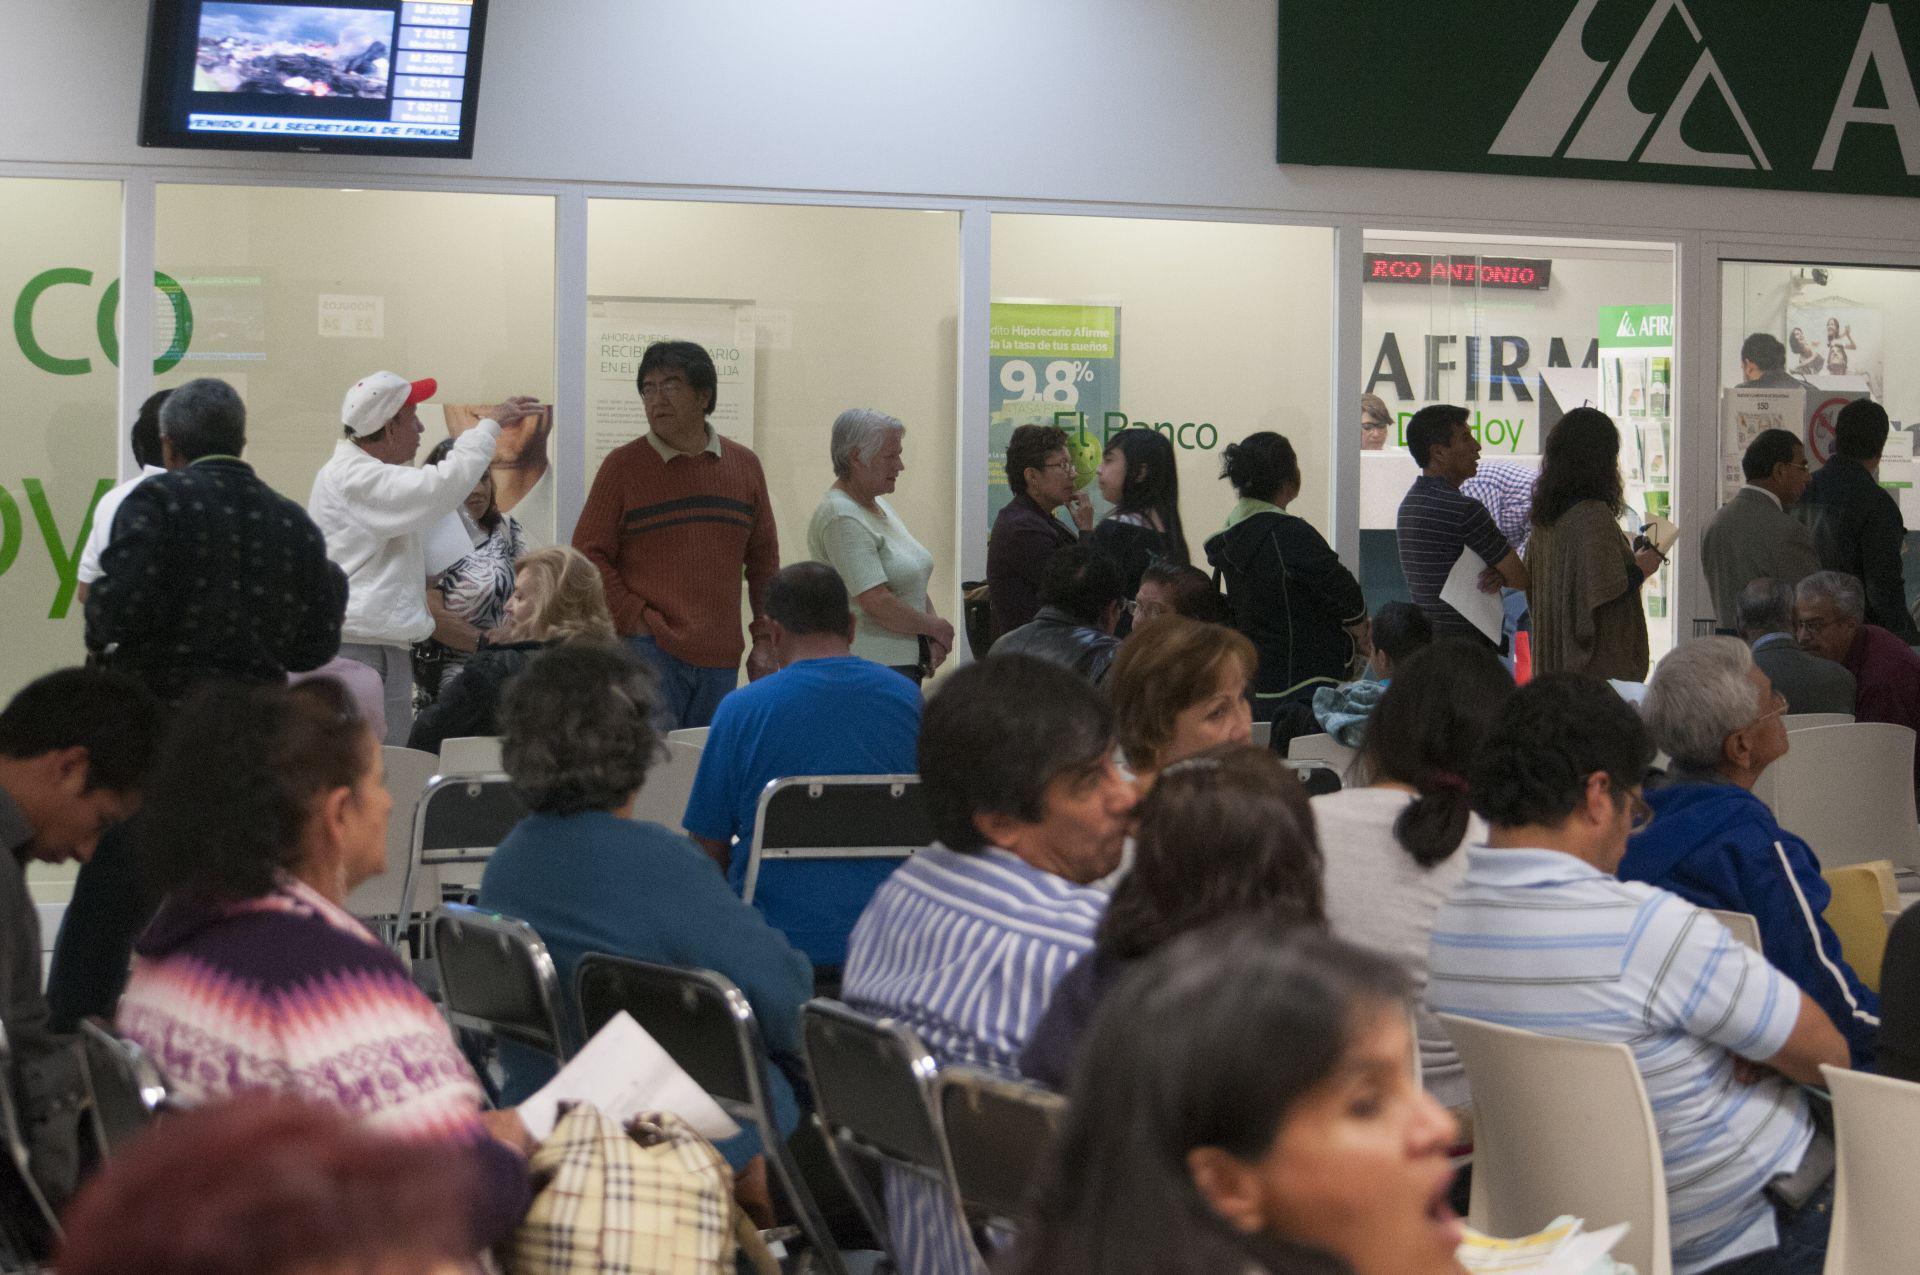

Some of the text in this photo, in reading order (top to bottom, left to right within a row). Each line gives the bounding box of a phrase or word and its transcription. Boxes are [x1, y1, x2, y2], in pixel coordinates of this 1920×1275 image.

[414, 28, 423, 39] T
[408, 77, 418, 88] T
[405, 101, 416, 112] T
[1431, 262, 1535, 284] ANTONIO
[601, 332, 635, 342] AHORA
[1012, 326, 1072, 337] Hipotecario
[1074, 327, 1110, 338] Afirme
[1015, 340, 1035, 350] tasa
[1037, 341, 1051, 350] de
[1053, 342, 1069, 351] tus
[1071, 342, 1108, 352] sueños
[601, 362, 617, 373] EN
[620, 363, 634, 374] EL
